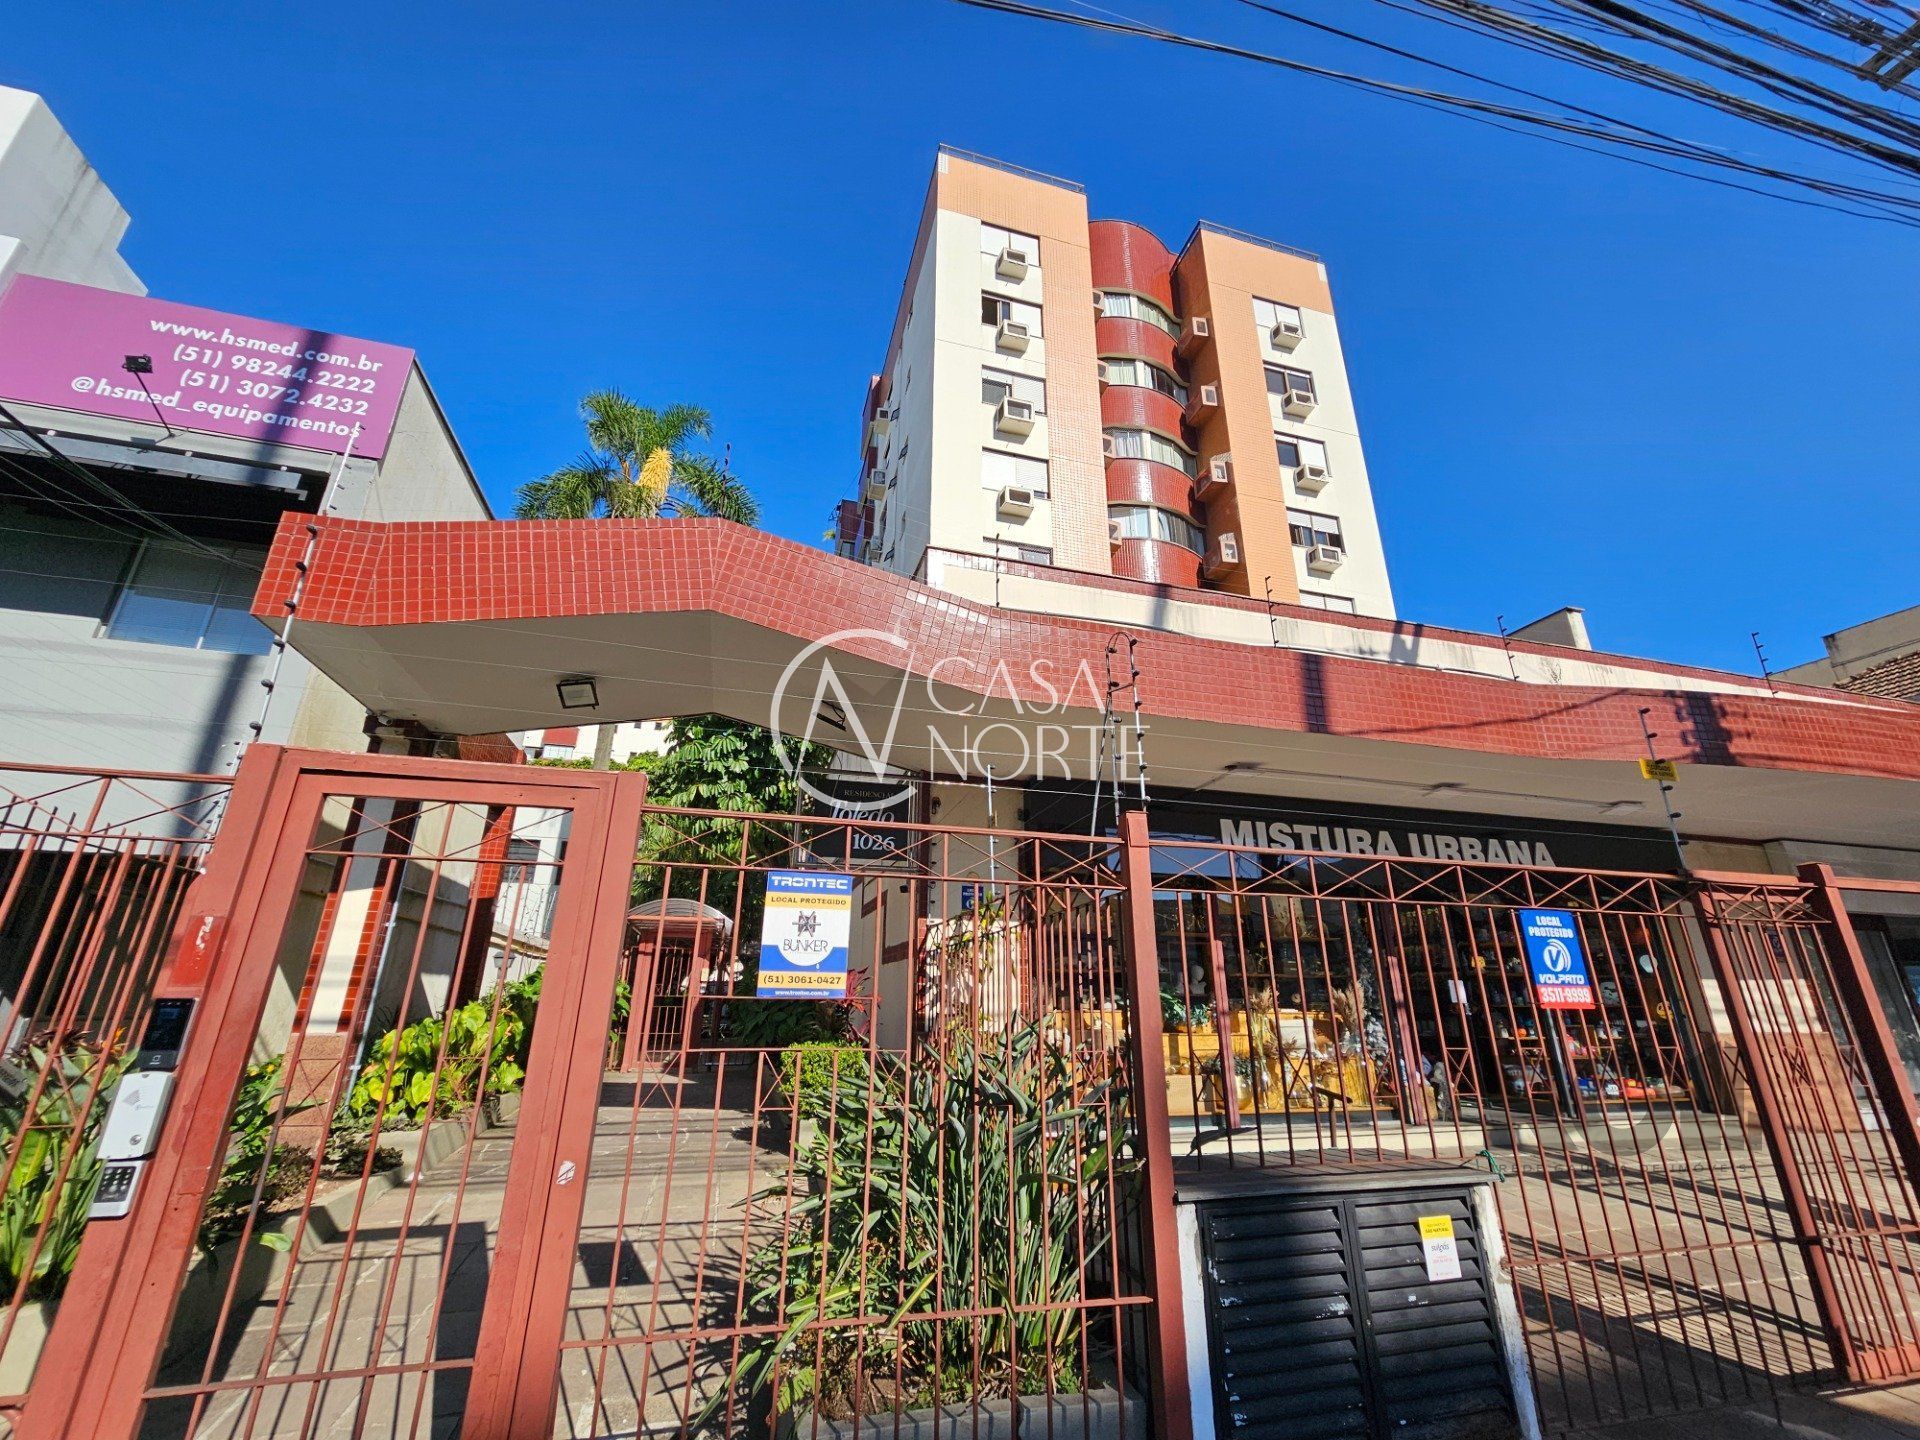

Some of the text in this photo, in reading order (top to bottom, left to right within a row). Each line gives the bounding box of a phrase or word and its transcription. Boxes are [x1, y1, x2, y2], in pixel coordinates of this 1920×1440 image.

[150, 320, 383, 372] www.hsmed.com.br
[173, 343, 376, 394] (51) 98244.2222
[180, 368, 369, 416] (51) 3072.4232
[71, 376, 361, 438] @hsmed_equipamentos
[852, 833, 896, 851] 1026
[1219, 818, 1556, 868] MISTURA URBANA
[771, 876, 848, 890] TRONTEC
[771, 896, 847, 906] LOCAL PROTEGIDO
[1536, 916, 1562, 927] LOCAL
[1528, 927, 1574, 938] PROTEGIDO
[783, 938, 829, 953] BUNKER
[763, 974, 842, 985] (51) 3061-0427
[1538, 973, 1585, 985] VOLPATO
[1540, 986, 1591, 1004] 3511-9999
